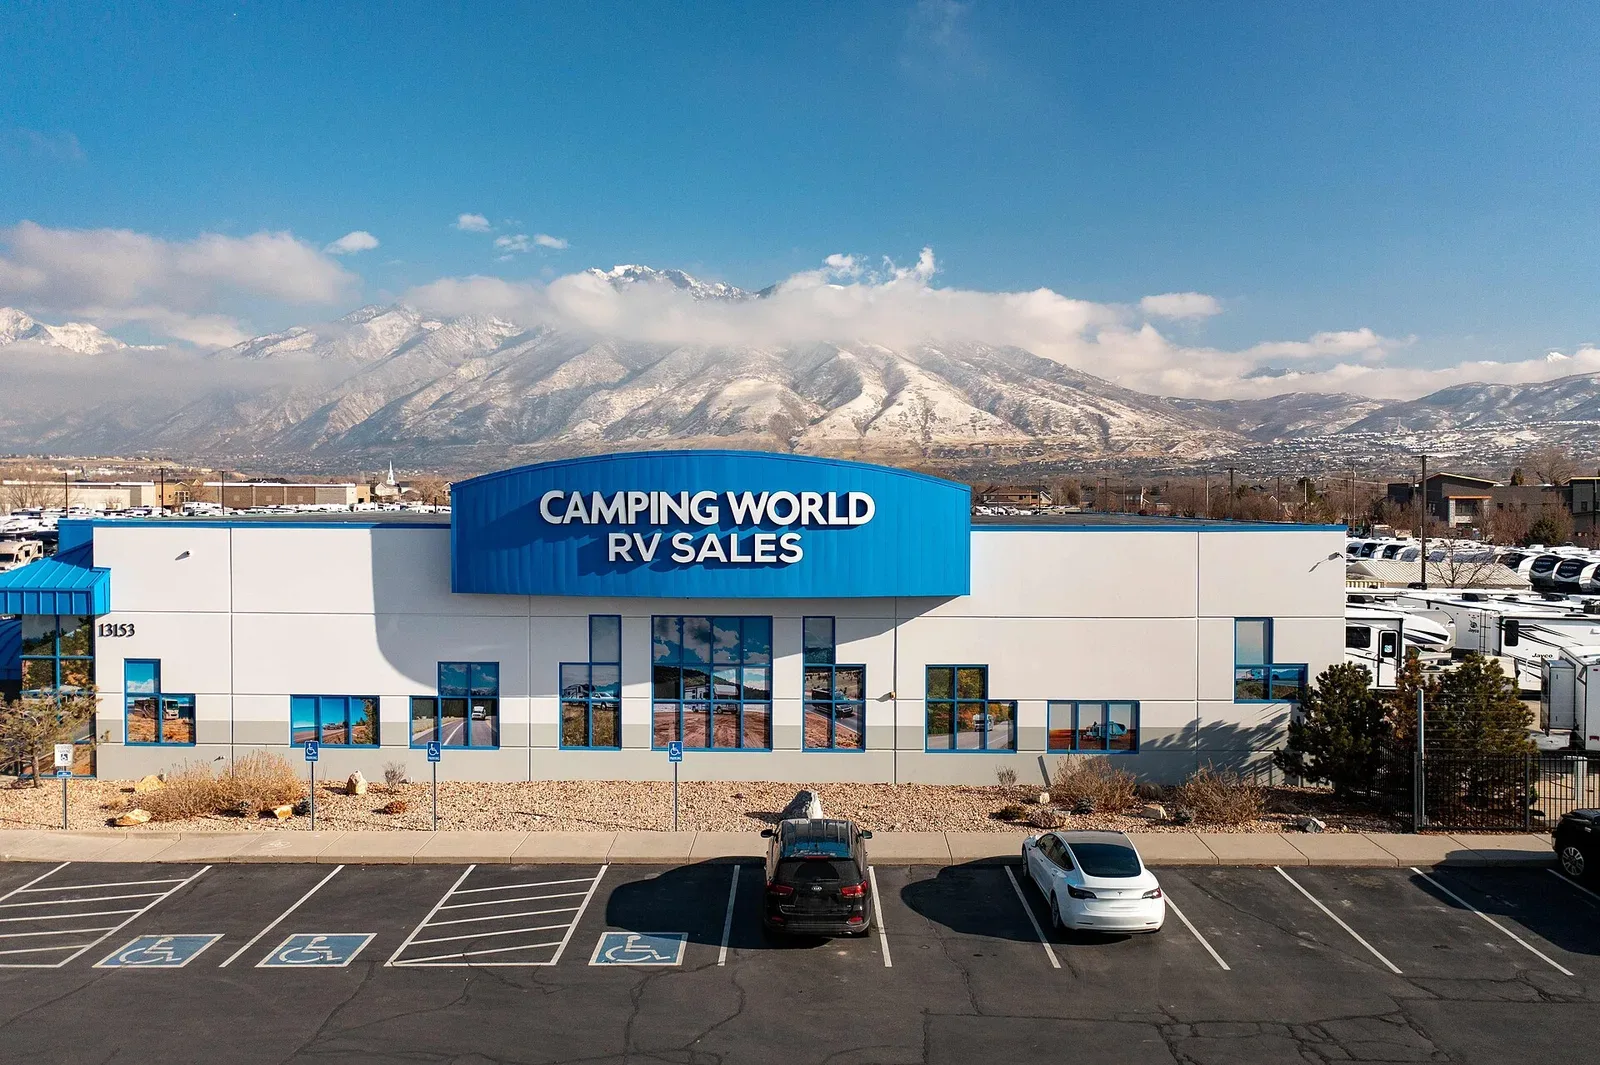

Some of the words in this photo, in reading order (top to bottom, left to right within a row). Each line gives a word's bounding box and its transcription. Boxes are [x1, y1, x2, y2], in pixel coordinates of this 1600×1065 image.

[539, 489, 720, 526] CAMPING
[726, 490, 876, 526] WORLD
[608, 532, 662, 562] RV
[671, 532, 804, 564] SALES
[98, 623, 136, 638] 13153
